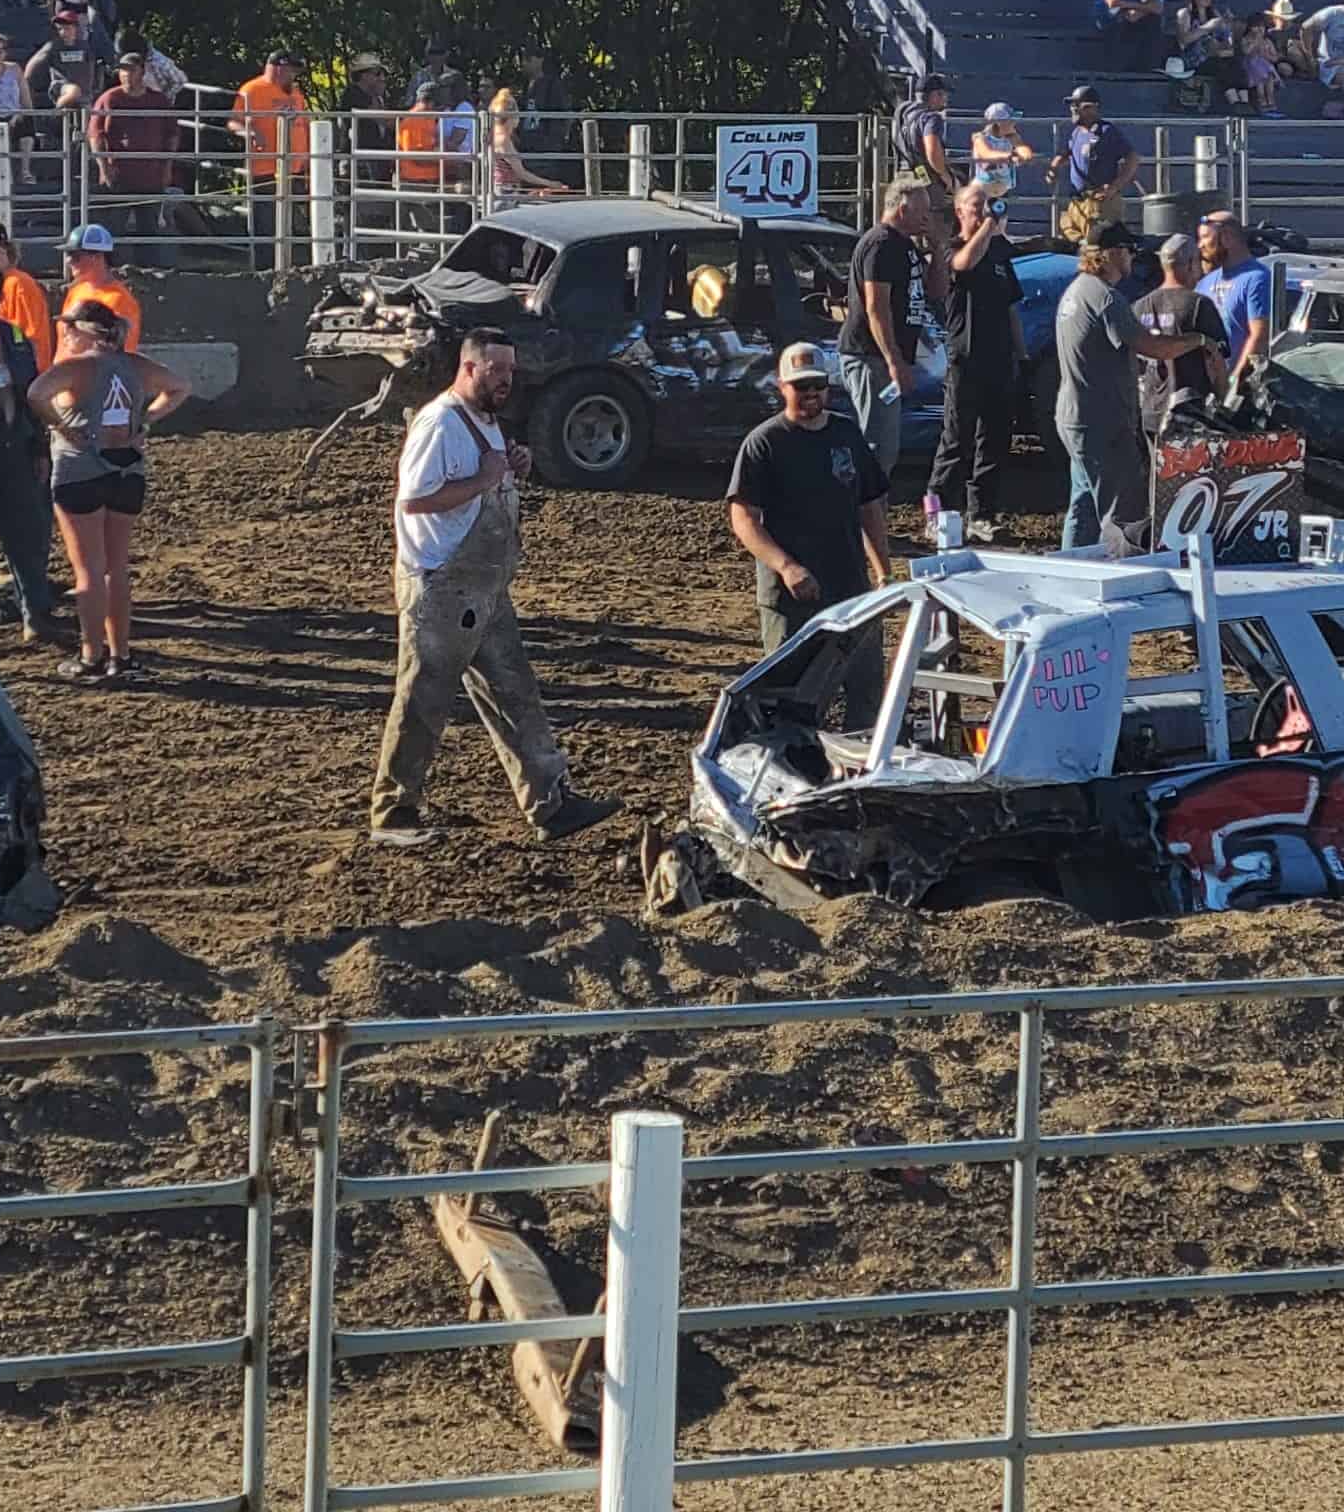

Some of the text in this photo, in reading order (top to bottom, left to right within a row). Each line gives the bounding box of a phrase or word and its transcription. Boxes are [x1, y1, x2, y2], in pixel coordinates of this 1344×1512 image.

[730, 130, 806, 143] COLLINS
[1253, 510, 1289, 541] JR
[1032, 683, 1100, 712] PUP
